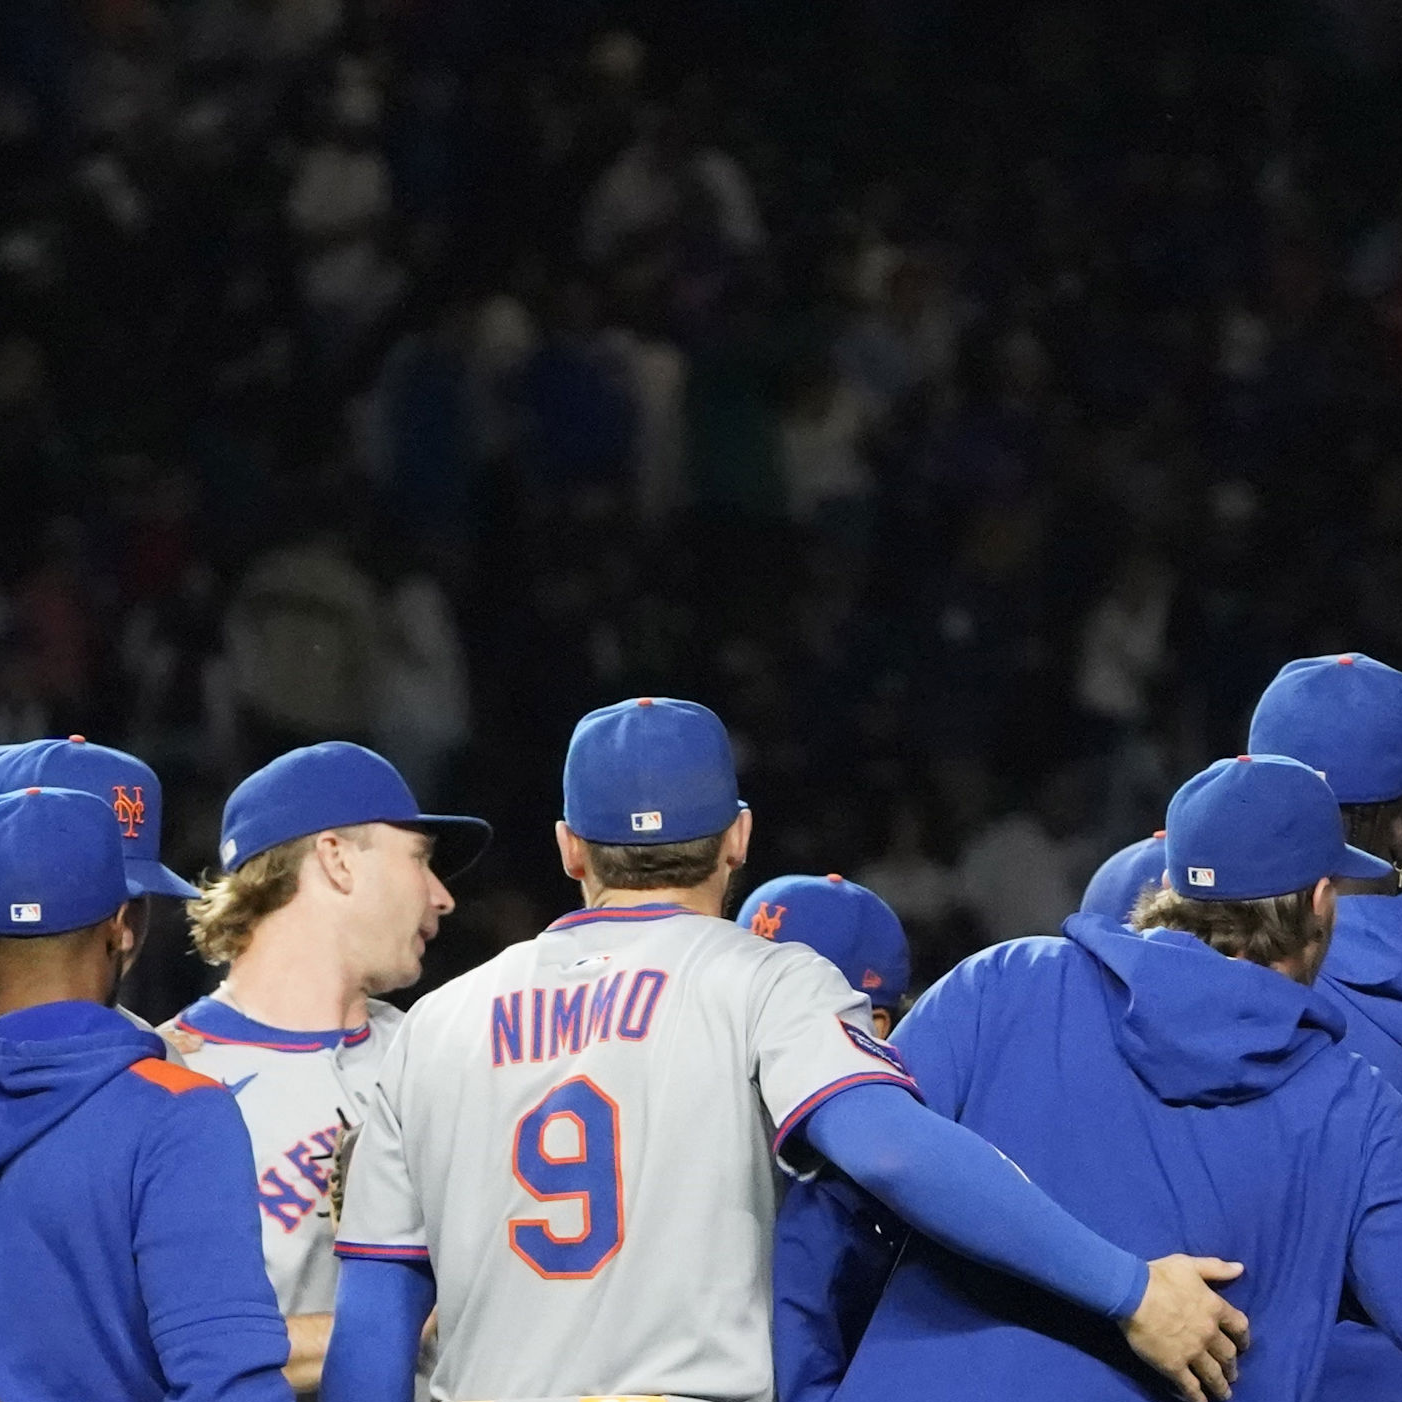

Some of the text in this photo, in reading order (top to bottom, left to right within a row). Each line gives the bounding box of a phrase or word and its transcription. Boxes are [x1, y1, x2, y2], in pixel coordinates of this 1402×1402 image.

[112, 785, 145, 838] NY
[490, 968, 669, 1068] NIMMO
[508, 1073, 625, 1280] 9
